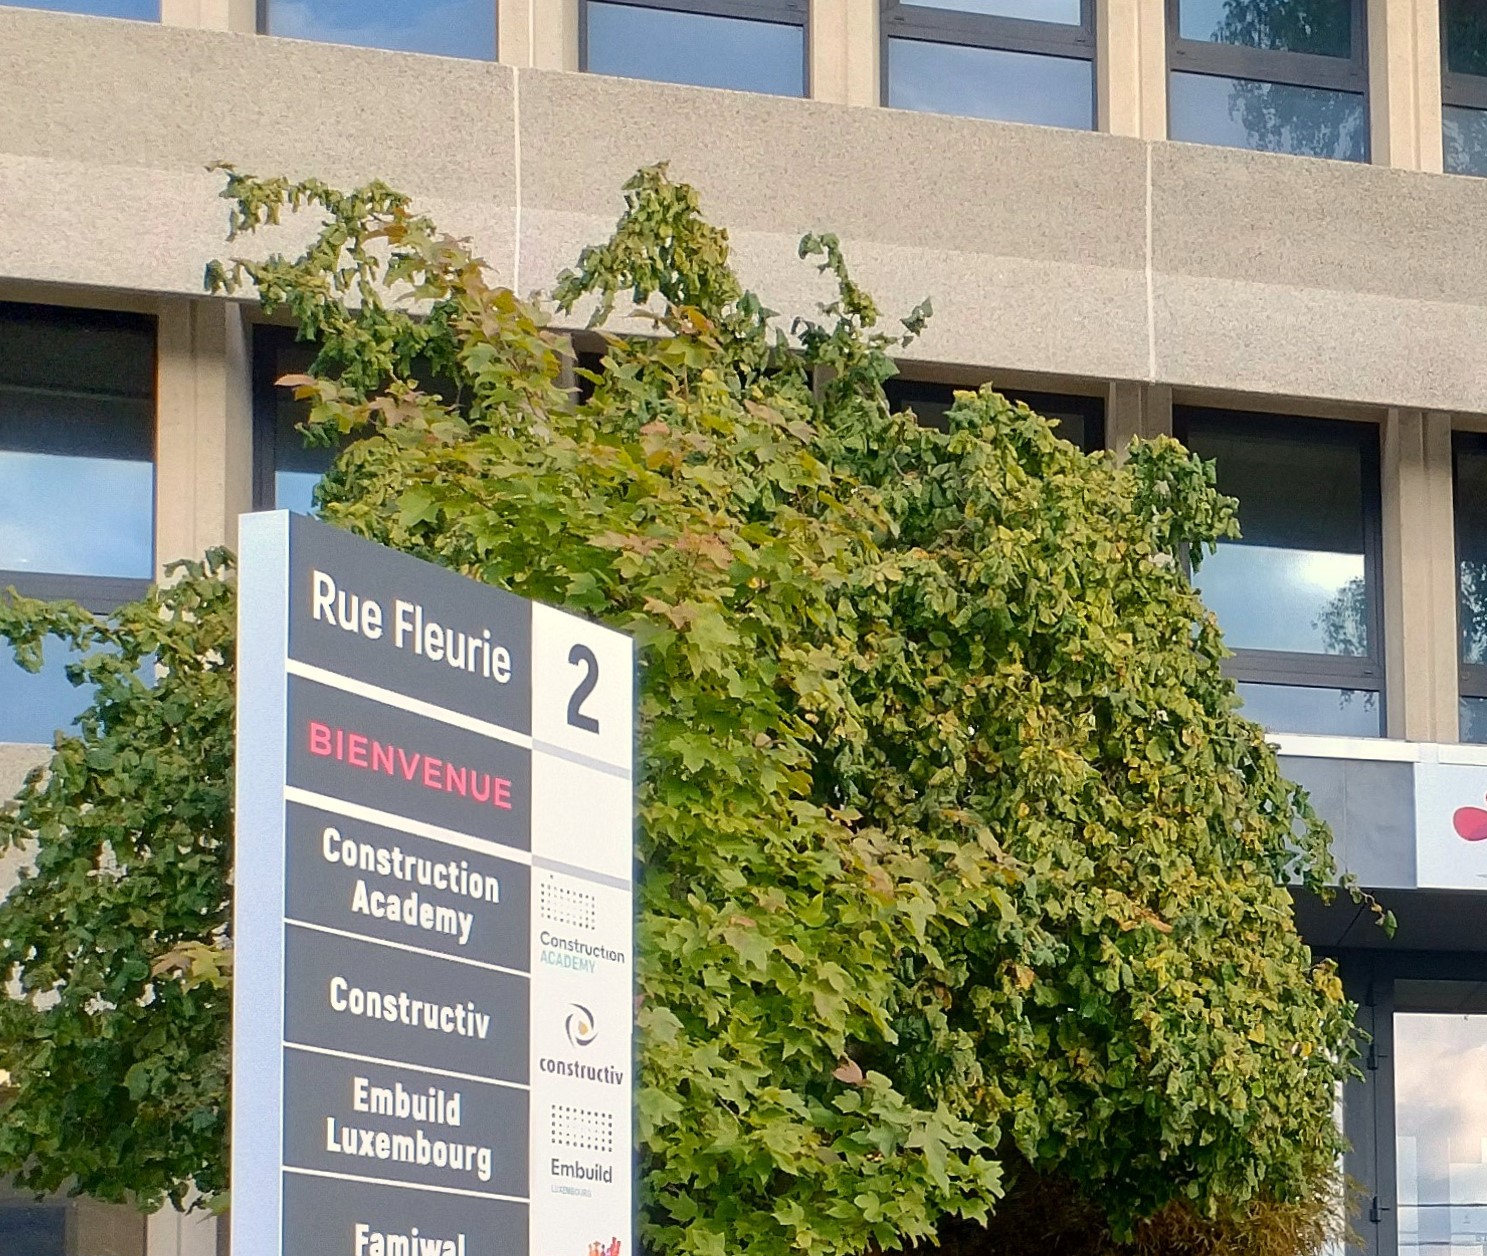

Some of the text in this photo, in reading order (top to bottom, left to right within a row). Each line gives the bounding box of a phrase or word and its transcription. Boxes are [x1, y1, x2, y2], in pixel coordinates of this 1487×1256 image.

[312, 570, 512, 685] Rue Fleurie
[567, 643, 600, 734] 2
[309, 722, 512, 809] BIENVENUE
[322, 826, 500, 903] Construction
[351, 880, 474, 945] Academy
[540, 931, 625, 963] Construction
[540, 950, 596, 973] ACADEMY
[329, 976, 491, 1039] Constructiv
[353, 1076, 460, 1127] Embuild
[540, 1058, 624, 1085] constructiv
[326, 1116, 492, 1182] Luxembourg
[551, 1158, 613, 1183] Embuild
